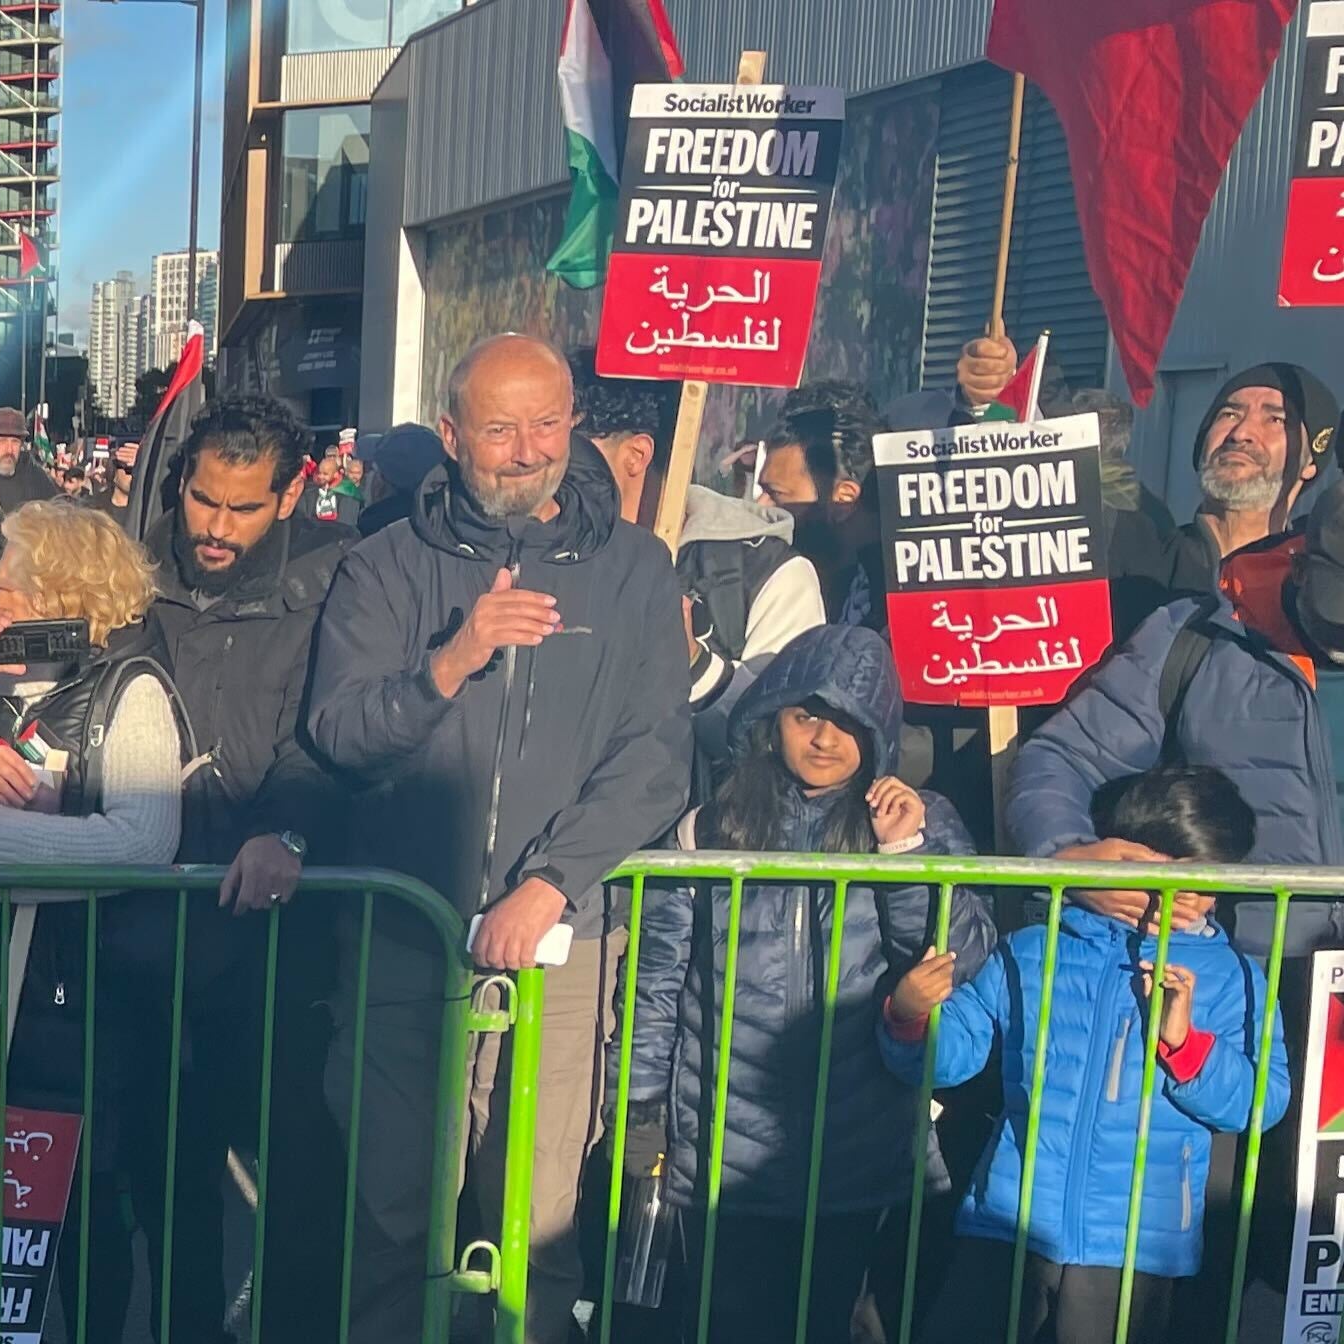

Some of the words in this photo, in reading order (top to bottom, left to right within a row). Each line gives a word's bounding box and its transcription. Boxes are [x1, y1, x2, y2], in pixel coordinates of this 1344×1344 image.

[644, 128, 820, 176] FREEDOM
[712, 174, 740, 198] for
[625, 198, 818, 249] PALESTINE
[649, 264, 771, 312] الحرية
[625, 311, 782, 356] لفلسطين
[898, 460, 1076, 516] FREEDOM
[973, 512, 1003, 534] for
[894, 527, 1093, 583] PALESTINE
[930, 596, 1059, 643] الحرية
[922, 636, 1083, 685] لفلسطين
